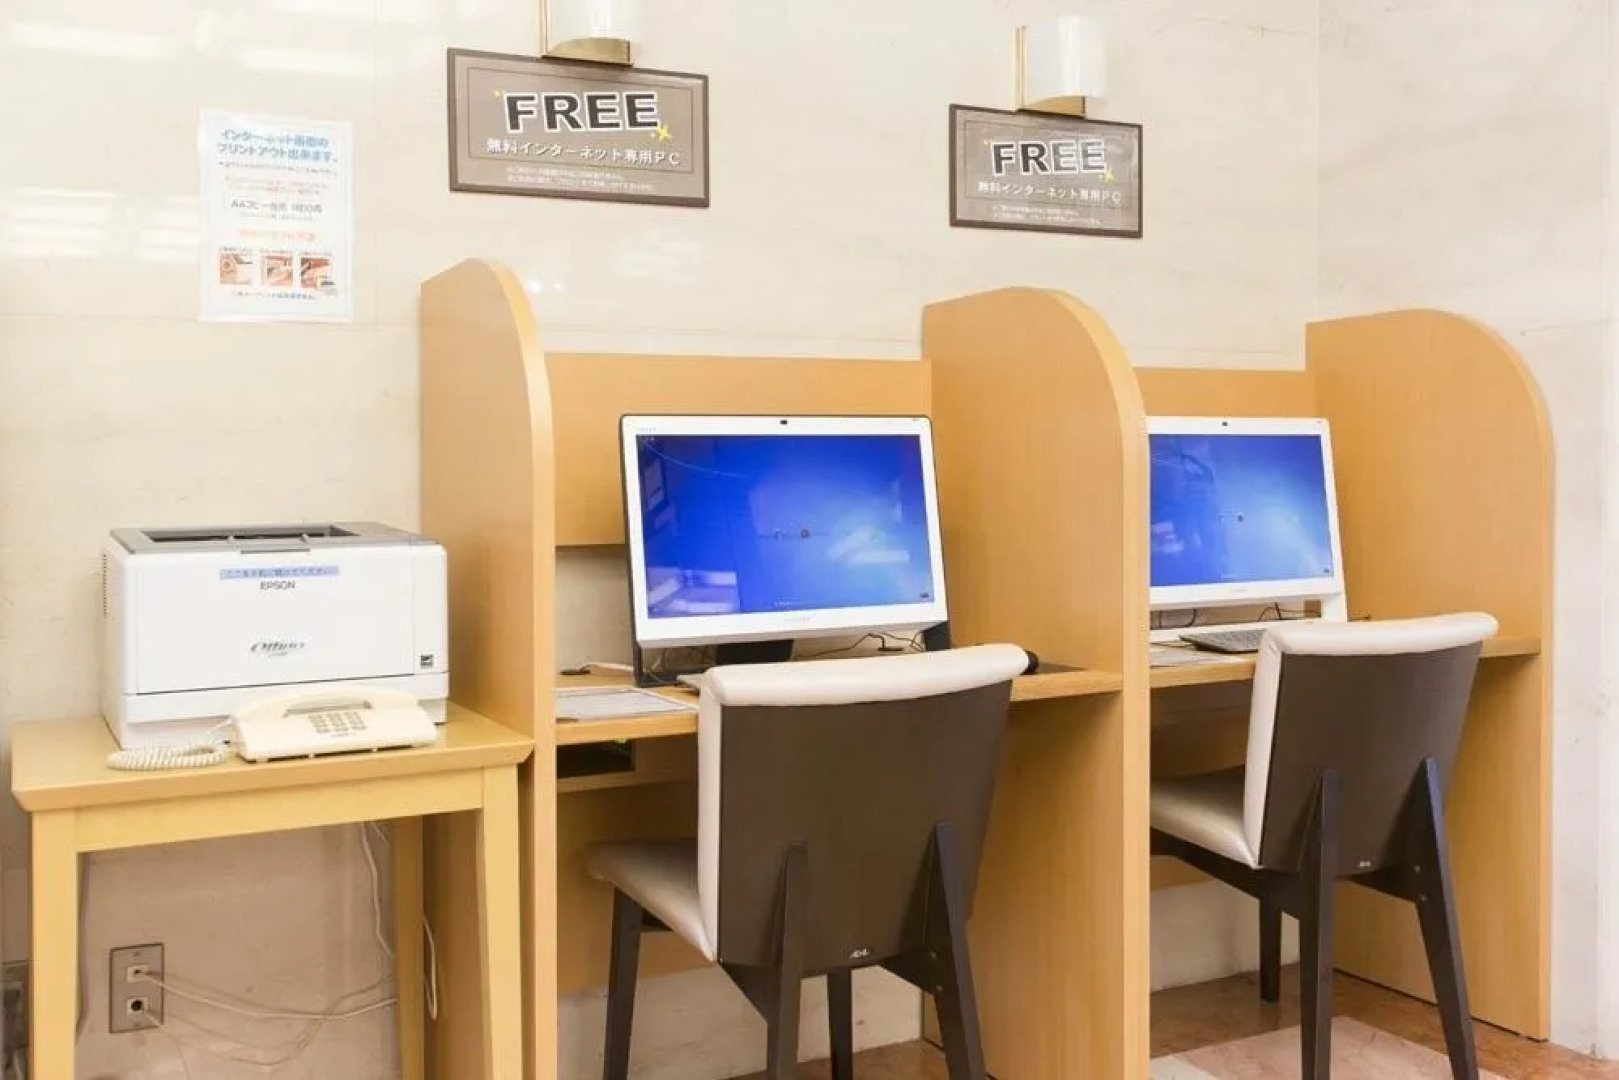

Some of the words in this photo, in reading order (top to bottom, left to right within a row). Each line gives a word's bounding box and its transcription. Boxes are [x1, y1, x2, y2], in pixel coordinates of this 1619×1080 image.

[504, 91, 660, 133] FREE
[990, 138, 1107, 177] FREE
[260, 580, 296, 591] EPSON
